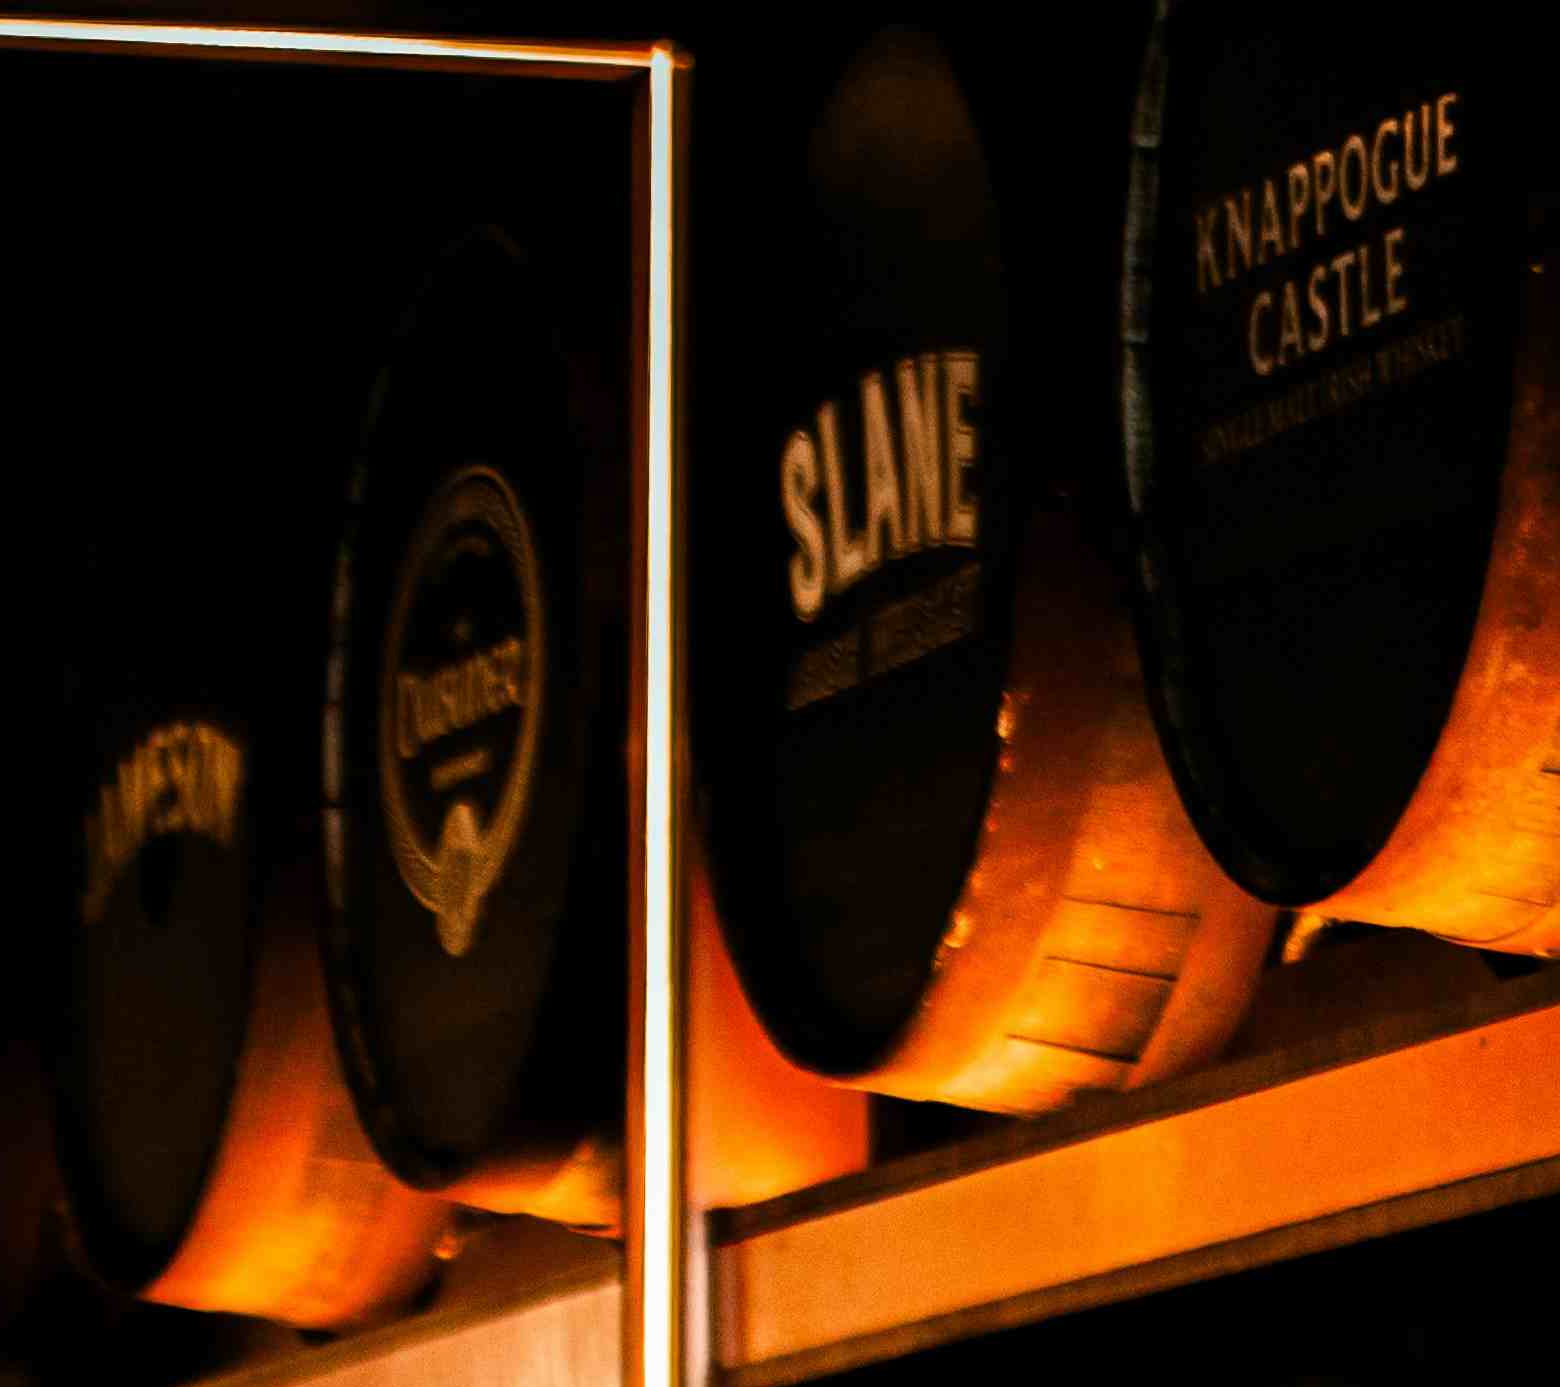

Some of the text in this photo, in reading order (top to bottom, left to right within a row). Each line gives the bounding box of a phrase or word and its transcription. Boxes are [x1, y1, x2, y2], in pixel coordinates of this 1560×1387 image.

[1193, 88, 1460, 296] KNAPPOGUE
[1247, 225, 1410, 378] CASTLE
[778, 346, 980, 624] SLANE
